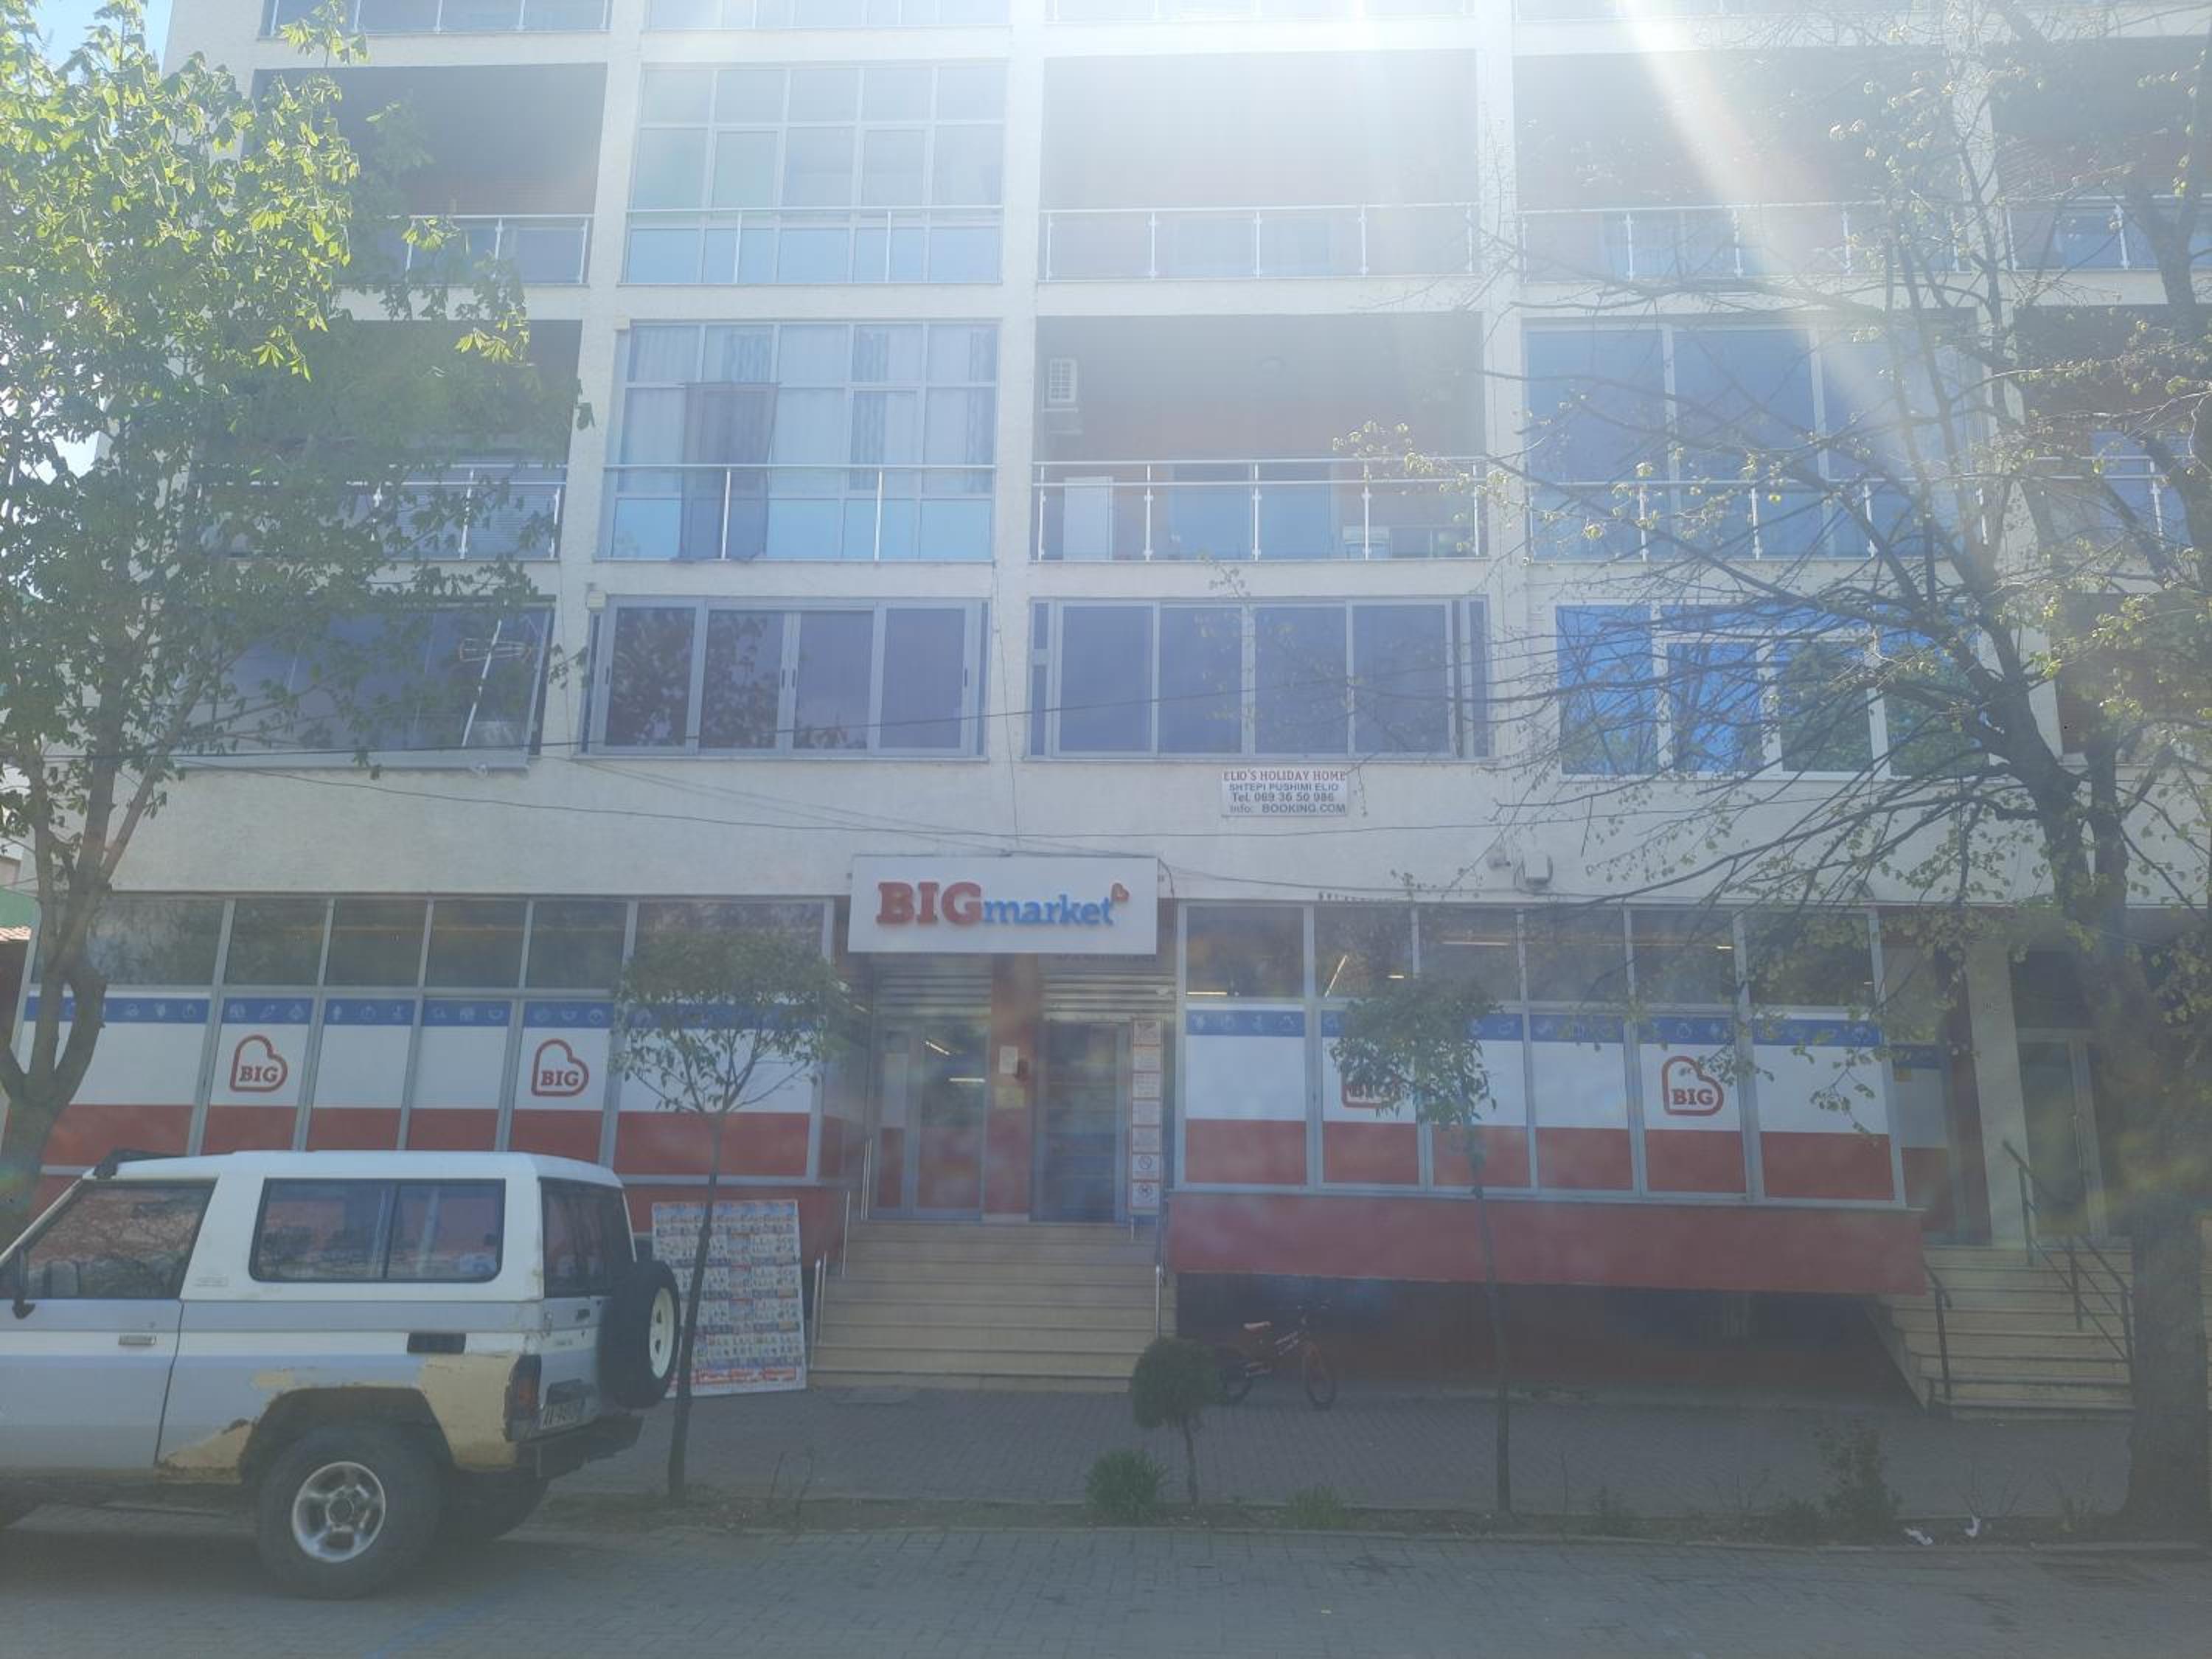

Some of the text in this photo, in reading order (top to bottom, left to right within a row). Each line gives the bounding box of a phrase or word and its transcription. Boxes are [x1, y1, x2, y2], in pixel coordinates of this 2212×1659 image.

[1260, 771, 1310, 781] HOLIDAY
[1313, 771, 1346, 781] HOME
[1269, 783, 1312, 791] PUSHIMI
[1315, 783, 1338, 791] ELIO
[239, 1065, 279, 1083] BIG
[540, 1070, 580, 1087] BIG
[1672, 1088, 1715, 1105] BIG
